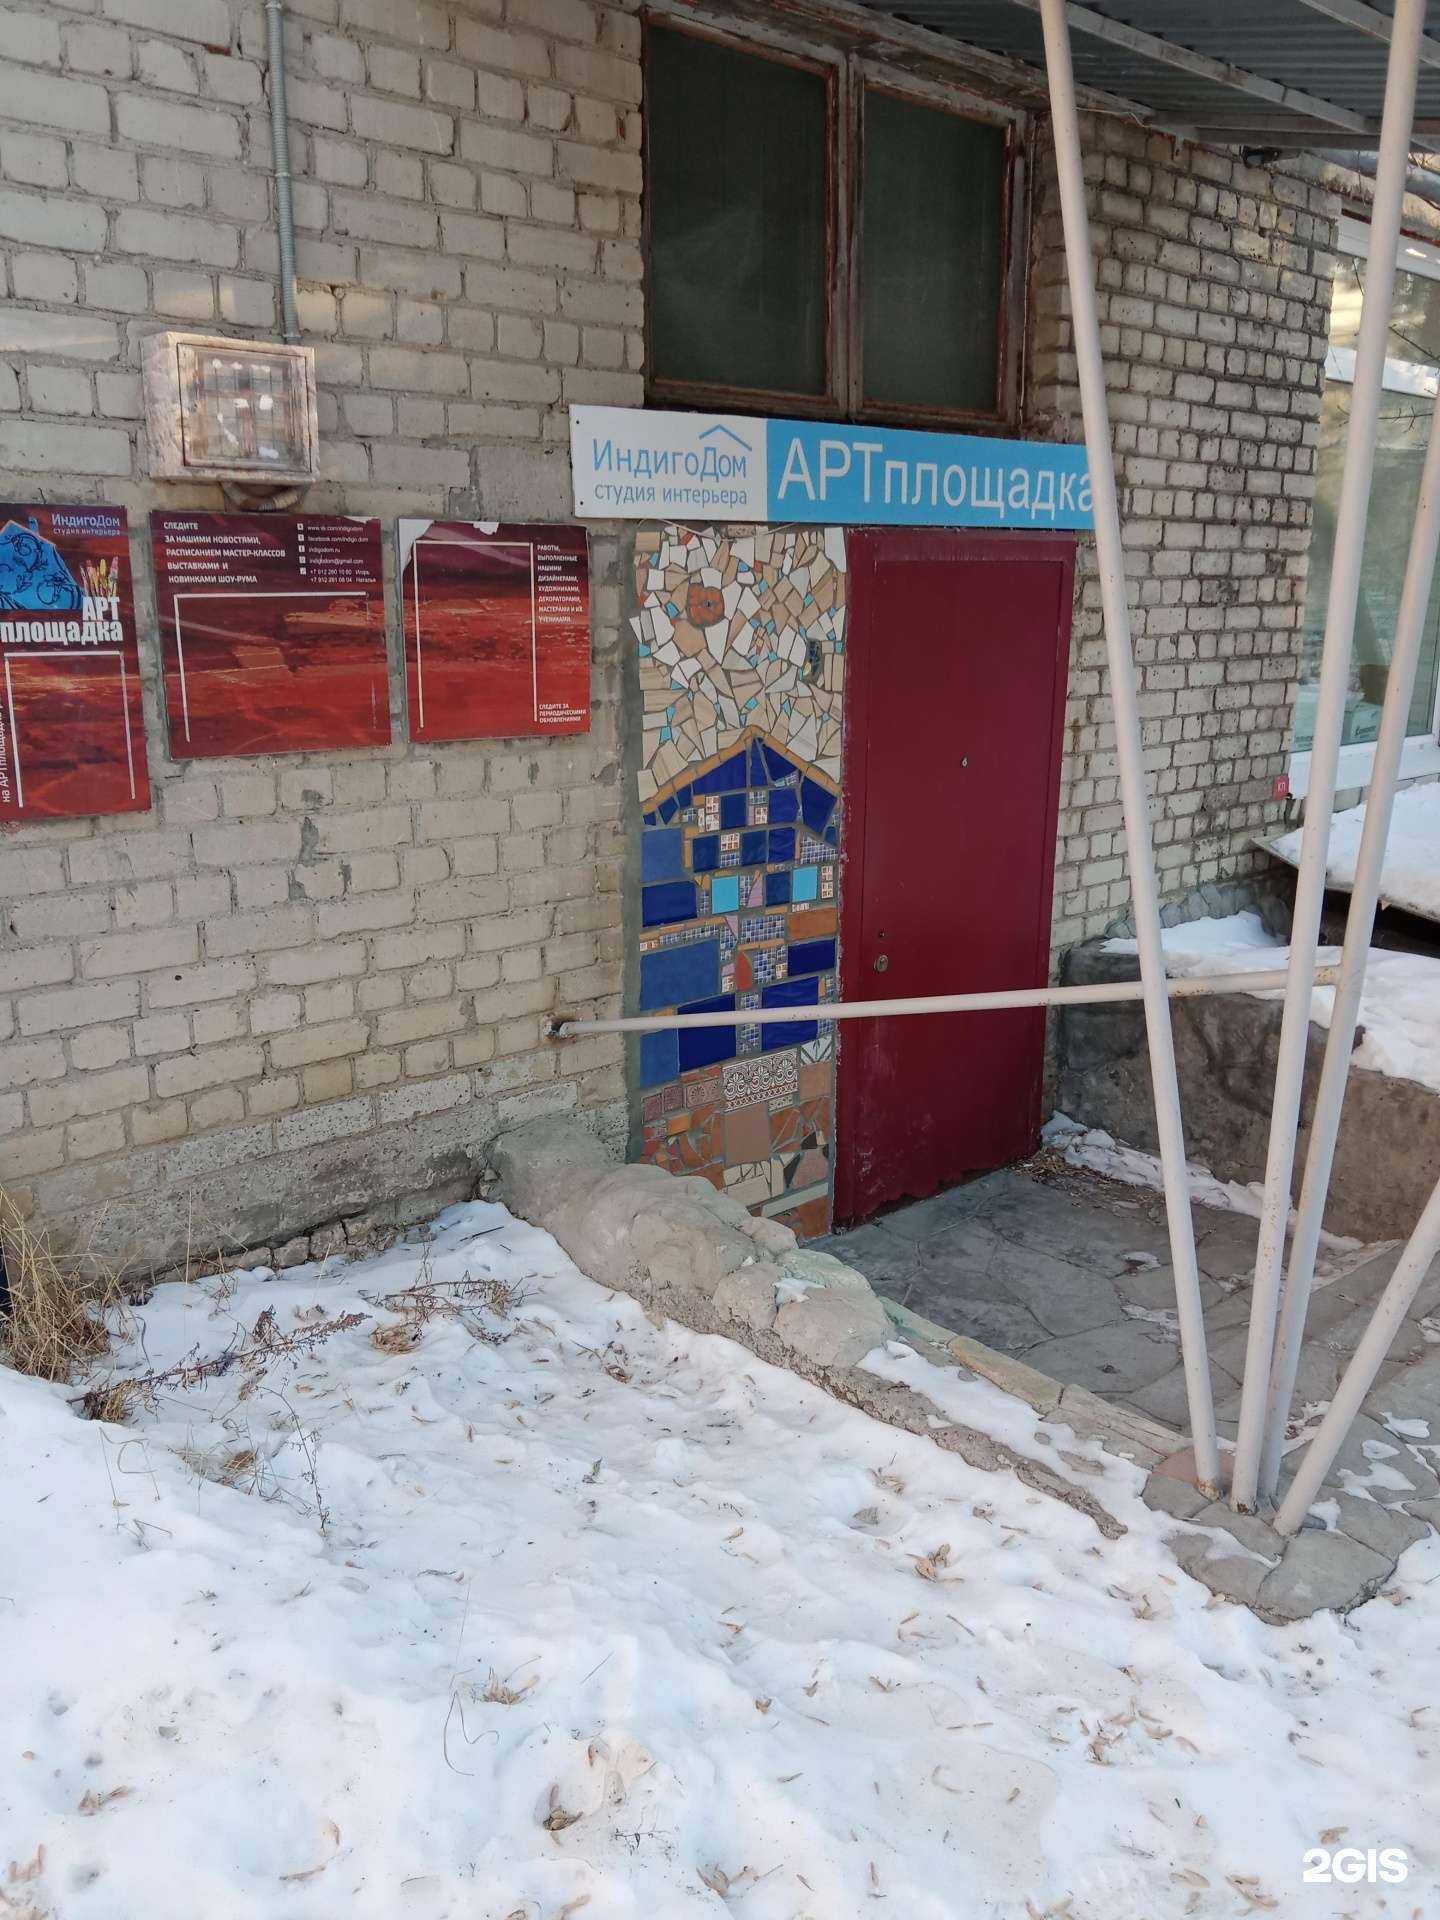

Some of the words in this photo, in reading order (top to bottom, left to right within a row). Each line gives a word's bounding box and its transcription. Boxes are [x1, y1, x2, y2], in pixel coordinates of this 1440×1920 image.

[593, 438, 747, 483] ИндигоДом
[777, 437, 1095, 521] АРТплощадка
[594, 483, 656, 505] студия
[662, 486, 748, 509] интерьера
[51, 513, 120, 528] ИндигоДом
[163, 521, 199, 531] СЛЕДИТЕ
[53, 527, 80, 536] студия
[164, 535, 175, 544] ЗА
[176, 535, 211, 544] НАШИМИ
[212, 536, 261, 545] НОВОСТЯМИ,
[166, 548, 222, 557] РАСПИСАНИЕМ
[223, 549, 286, 558] МАСТЕР-КЛАССОВ
[167, 562, 219, 570] ВЫСТАВКАМИ
[222, 562, 229, 570] И
[169, 575, 217, 584] НОВИНКАМИ
[218, 575, 258, 584] ШОУ-РУМА
[82, 596, 120, 622] АРТ
[0, 621, 123, 645] площадка
